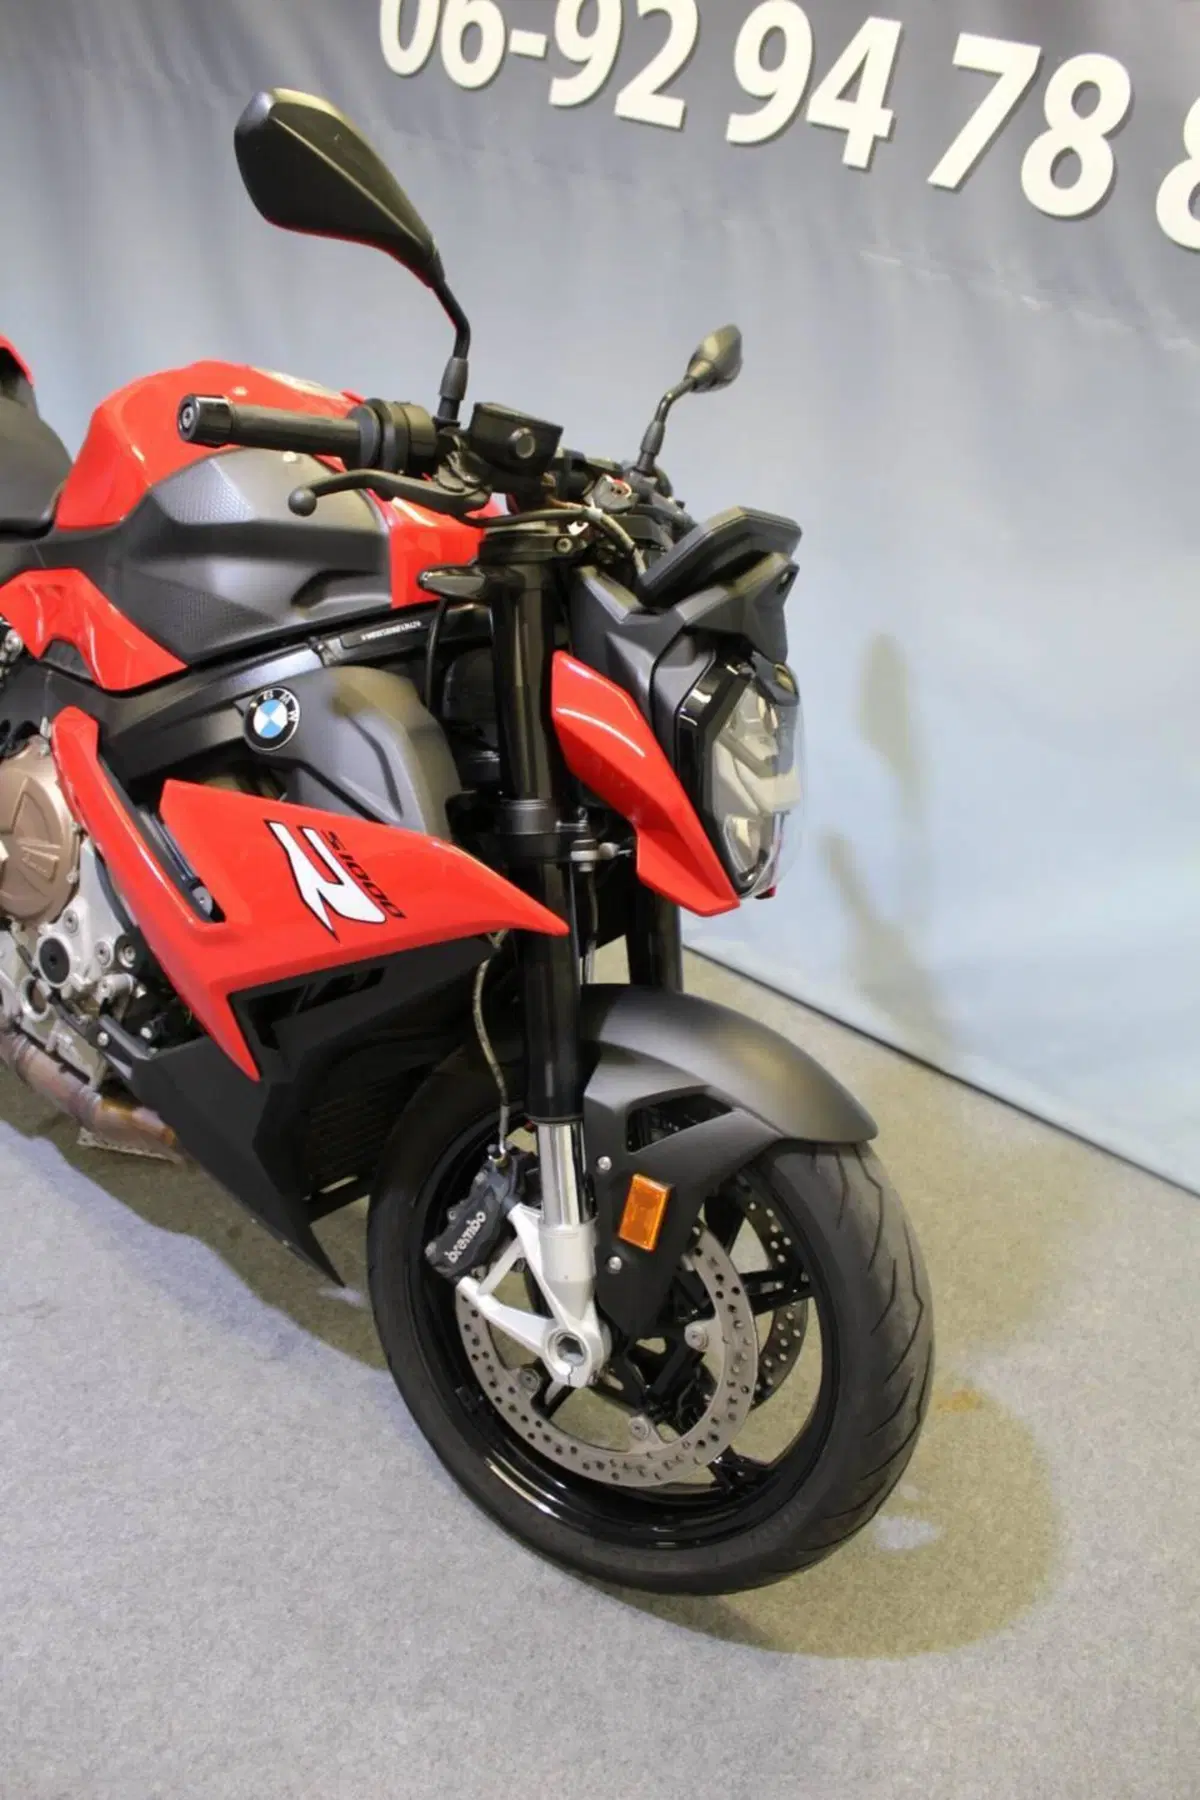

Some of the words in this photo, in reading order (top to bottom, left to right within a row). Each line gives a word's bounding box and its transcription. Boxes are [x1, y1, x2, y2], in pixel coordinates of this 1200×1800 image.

[379, 0, 697, 129] 06-92
[726, 0, 902, 169] 94
[927, 32, 1131, 217] 78
[444, 1211, 487, 1264] brembo
